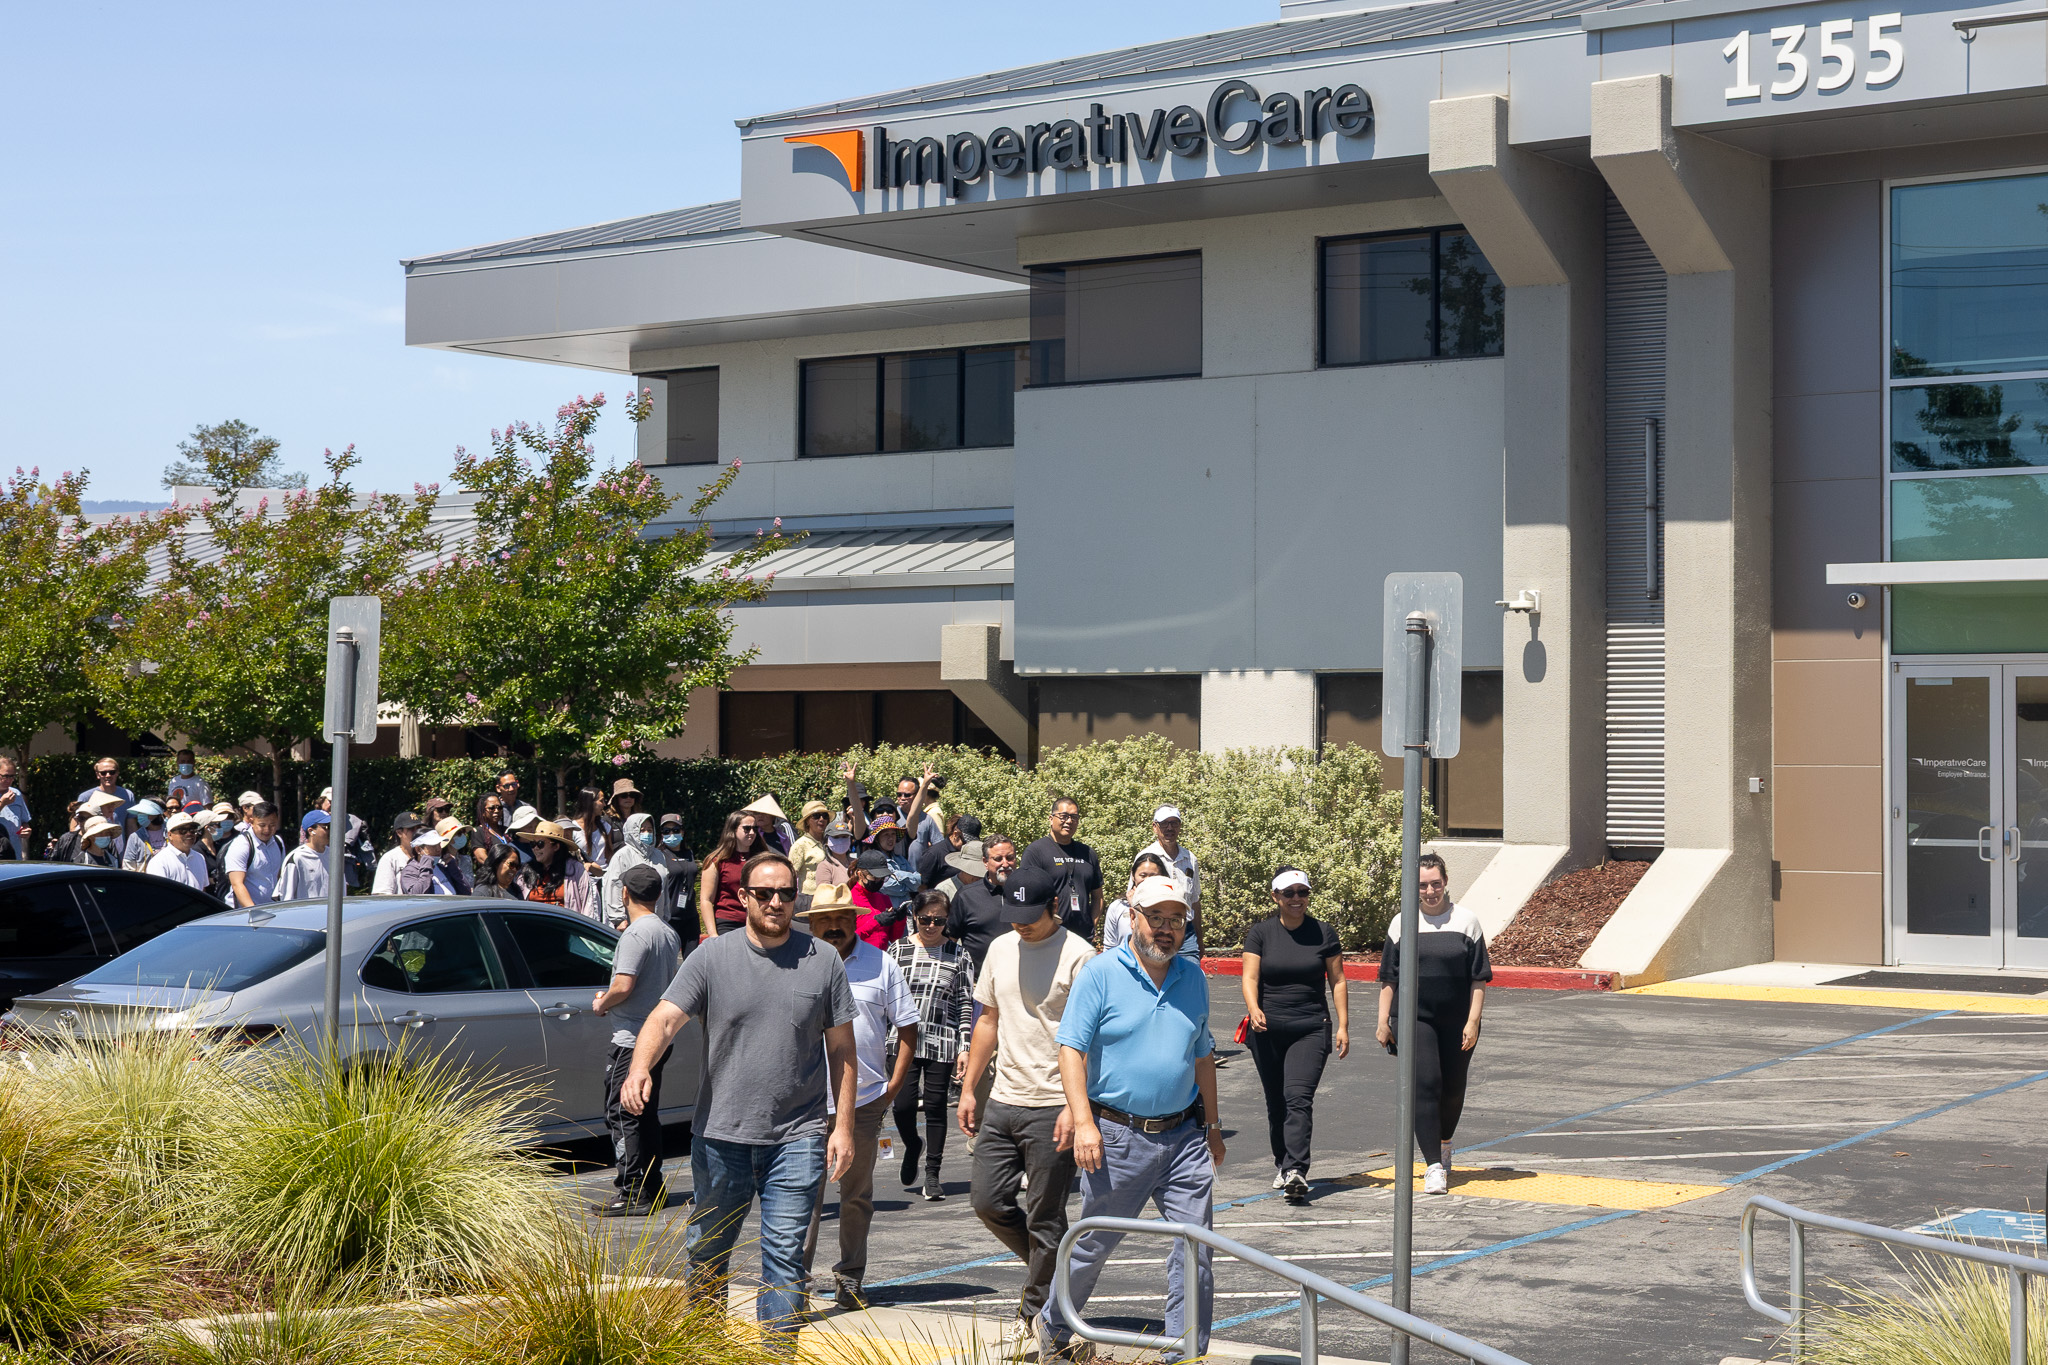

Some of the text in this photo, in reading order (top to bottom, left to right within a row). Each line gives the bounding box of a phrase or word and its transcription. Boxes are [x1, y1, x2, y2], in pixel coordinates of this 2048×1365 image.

[1722, 12, 1904, 100] 1355
[873, 80, 1373, 199] ImperativeCare
[1923, 758, 1987, 768] ImperativeCare
